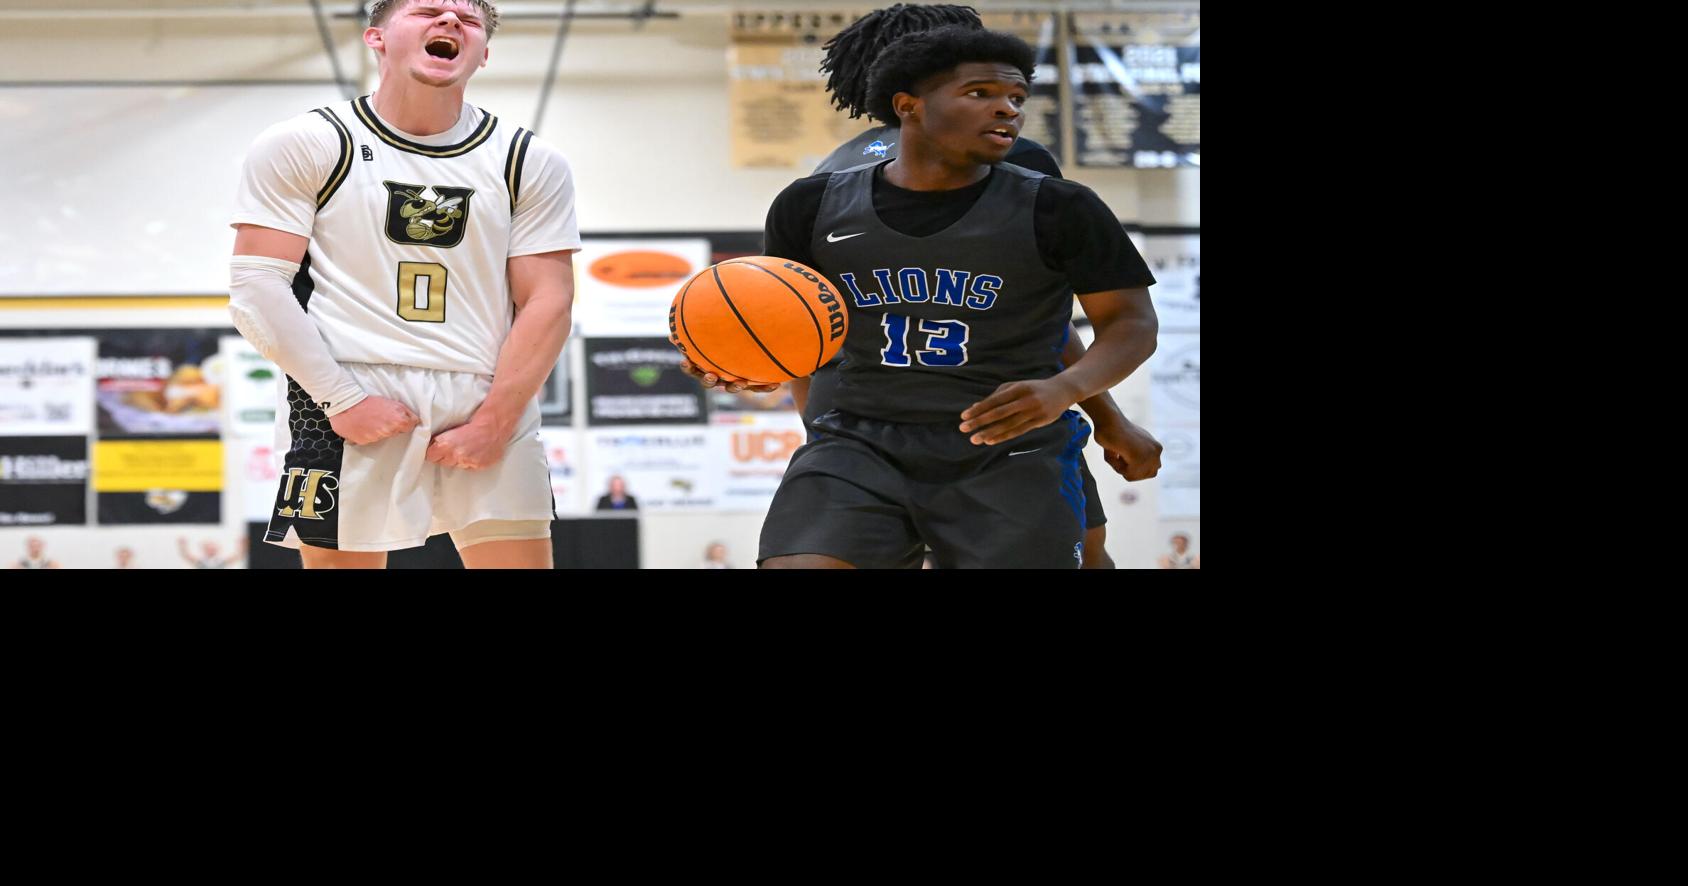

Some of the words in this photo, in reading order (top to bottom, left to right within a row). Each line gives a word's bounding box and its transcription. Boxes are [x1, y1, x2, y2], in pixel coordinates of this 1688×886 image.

[397, 261, 448, 323] 0
[783, 262, 845, 342] Wilson
[840, 267, 1003, 310] LIONS
[880, 312, 969, 368] 13
[275, 467, 340, 520] UHS
